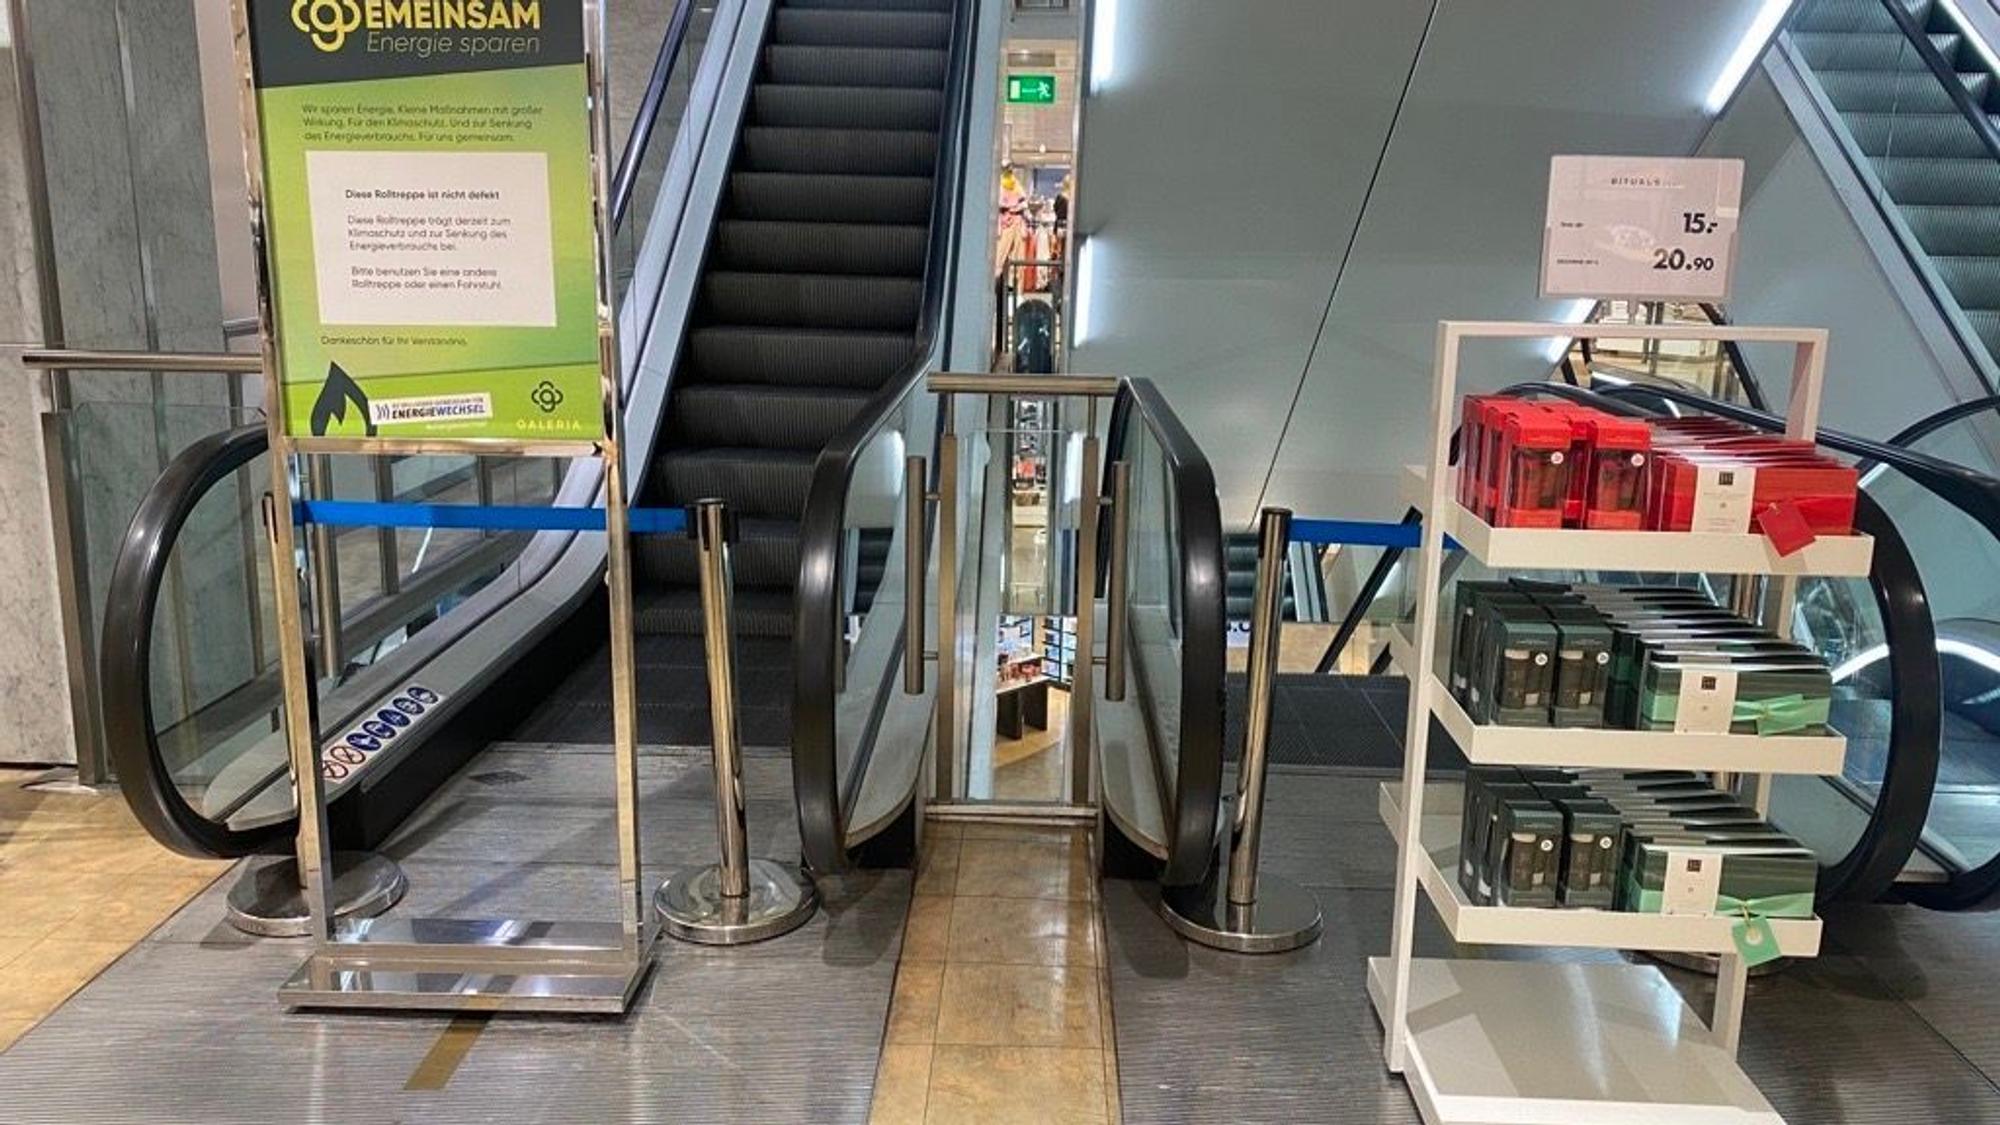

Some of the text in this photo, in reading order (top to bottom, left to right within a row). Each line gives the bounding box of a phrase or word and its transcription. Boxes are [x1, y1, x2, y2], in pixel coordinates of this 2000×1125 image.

[366, 31, 540, 58] Energie sparen
[302, 104, 318, 114] Wir
[321, 105, 355, 116] sparen
[398, 103, 428, 114] Kleine
[430, 104, 492, 115] Maßnahmen
[493, 104, 508, 115] mit
[512, 104, 543, 116] großer
[348, 118, 364, 128] Für
[366, 118, 385, 128] den
[450, 118, 470, 128] Und
[472, 120, 487, 129] zur
[490, 118, 533, 130] Senkung
[304, 131, 322, 141] des
[419, 131, 435, 142] Für
[436, 134, 453, 142] uns
[345, 189, 500, 201] Diese Rolltreppe ist nicht defekt
[348, 215, 512, 228] Diese Rolltreppe trägt derzeit zum
[348, 229, 508, 241] Klimaschutz und zur Senkung des
[350, 240, 438, 252] Energieverbrauchs
[1653, 248, 1714, 271] 20.90
[351, 266, 498, 277] Bitte benutzen Sie eine andere
[351, 279, 402, 291] Rolltreppe
[404, 280, 427, 289] oder
[429, 280, 456, 290] einen
[320, 335, 380, 345] Dankeschön
[382, 335, 396, 345] für
[397, 336, 409, 345] Ihr
[516, 419, 581, 431] GALERIA
